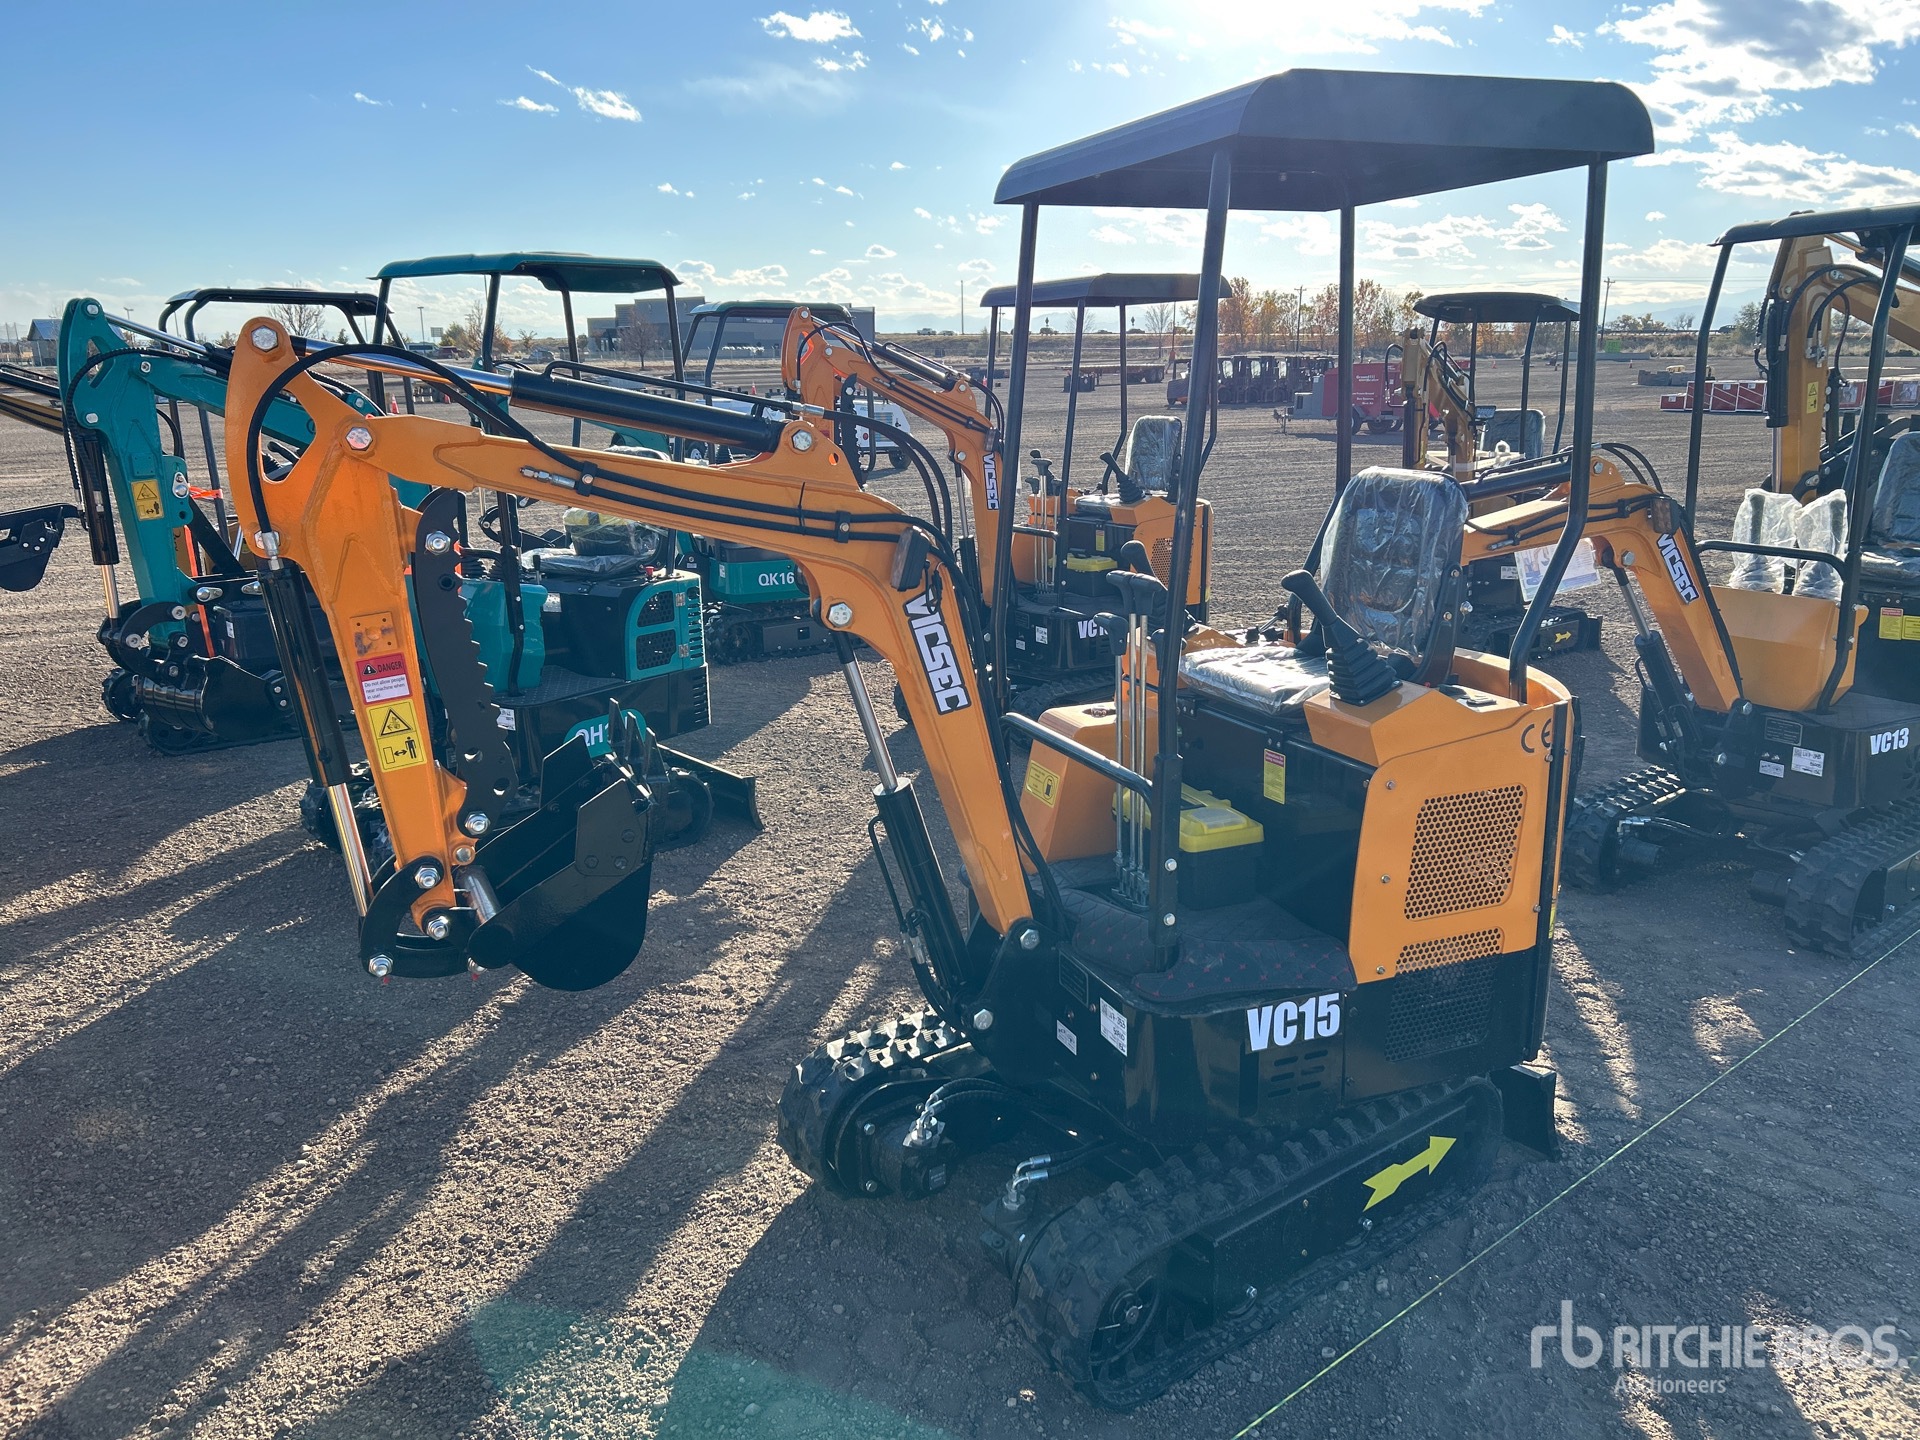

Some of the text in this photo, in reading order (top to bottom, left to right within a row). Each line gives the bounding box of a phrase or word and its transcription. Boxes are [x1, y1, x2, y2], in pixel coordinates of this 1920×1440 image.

[983, 453, 999, 510] VICSEC
[758, 572, 794, 586] QK16
[1657, 533, 1699, 605] VICSEC
[378, 661, 402, 673] DANGER
[904, 587, 970, 714] VICSEC
[1870, 727, 1910, 756] VC13
[1247, 992, 1340, 1052] VC15
